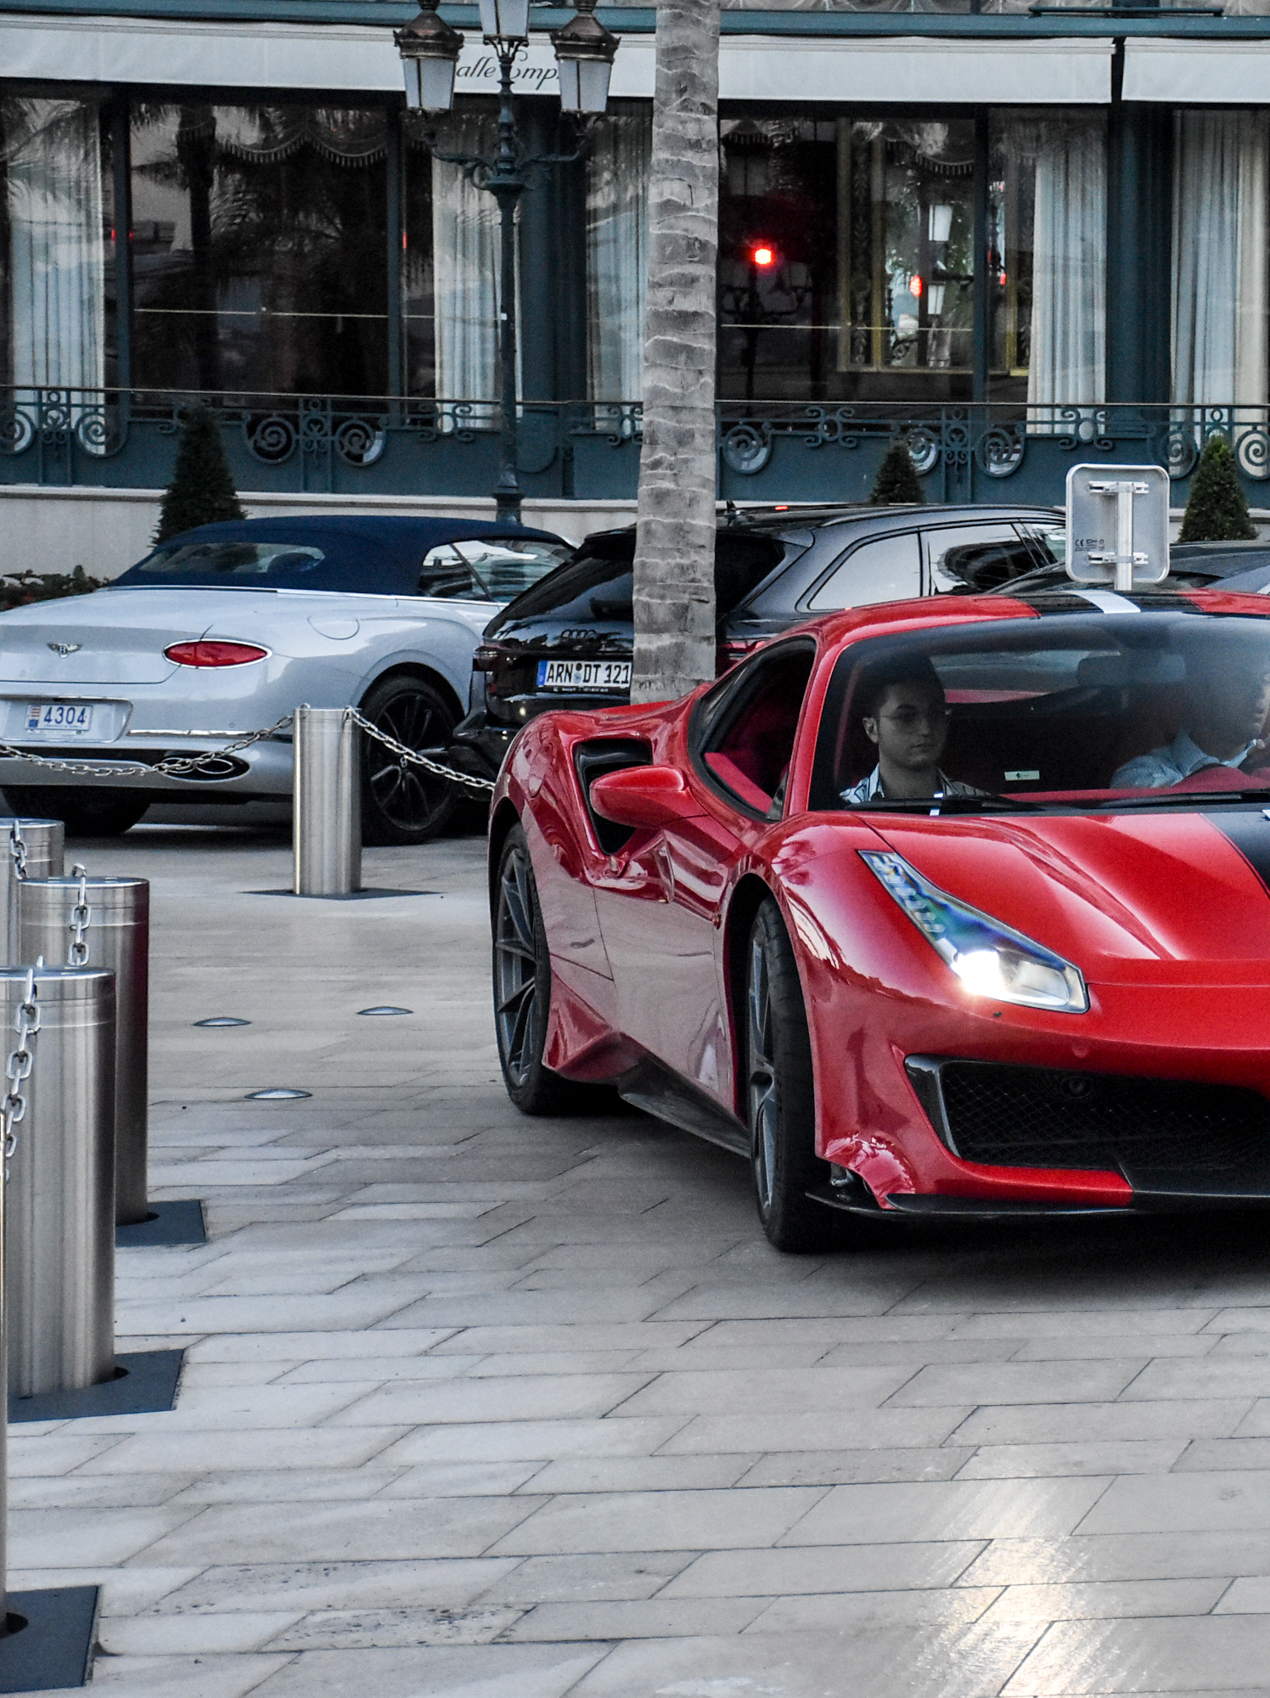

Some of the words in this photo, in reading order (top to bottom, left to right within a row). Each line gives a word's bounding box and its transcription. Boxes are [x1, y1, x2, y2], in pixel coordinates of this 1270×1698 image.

[456, 56, 496, 78] alle
[546, 663, 574, 683] ARN
[583, 664, 602, 683] DT
[603, 664, 630, 684] 121
[43, 706, 86, 725] 4304
